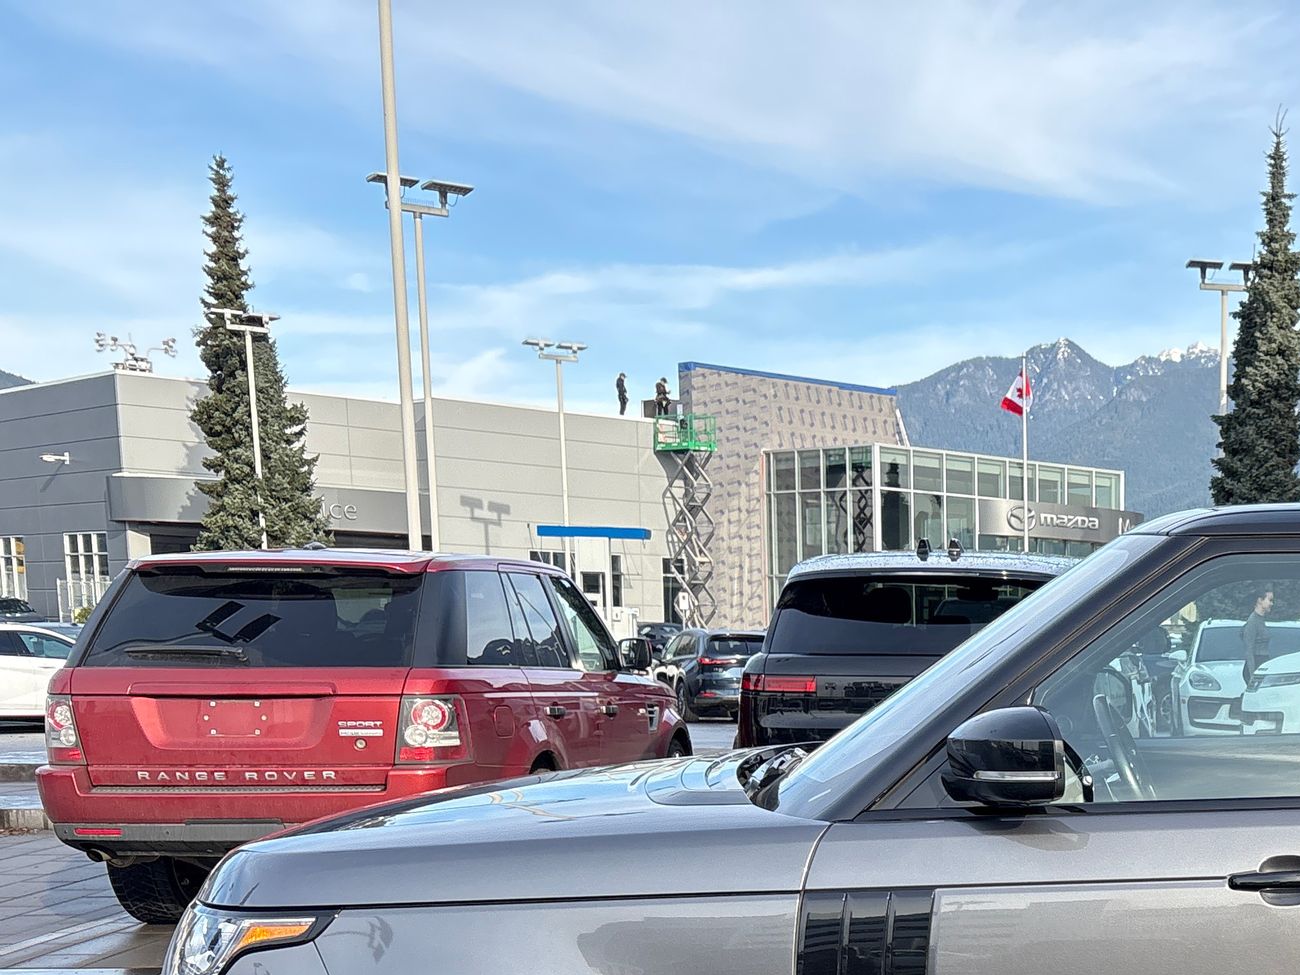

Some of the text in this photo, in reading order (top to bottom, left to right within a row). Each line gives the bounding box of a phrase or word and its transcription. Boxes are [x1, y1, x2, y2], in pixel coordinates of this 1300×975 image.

[1040, 513, 1099, 530] mazda
[337, 720, 383, 728] SPORT
[136, 770, 337, 781] RANGE ROVER
